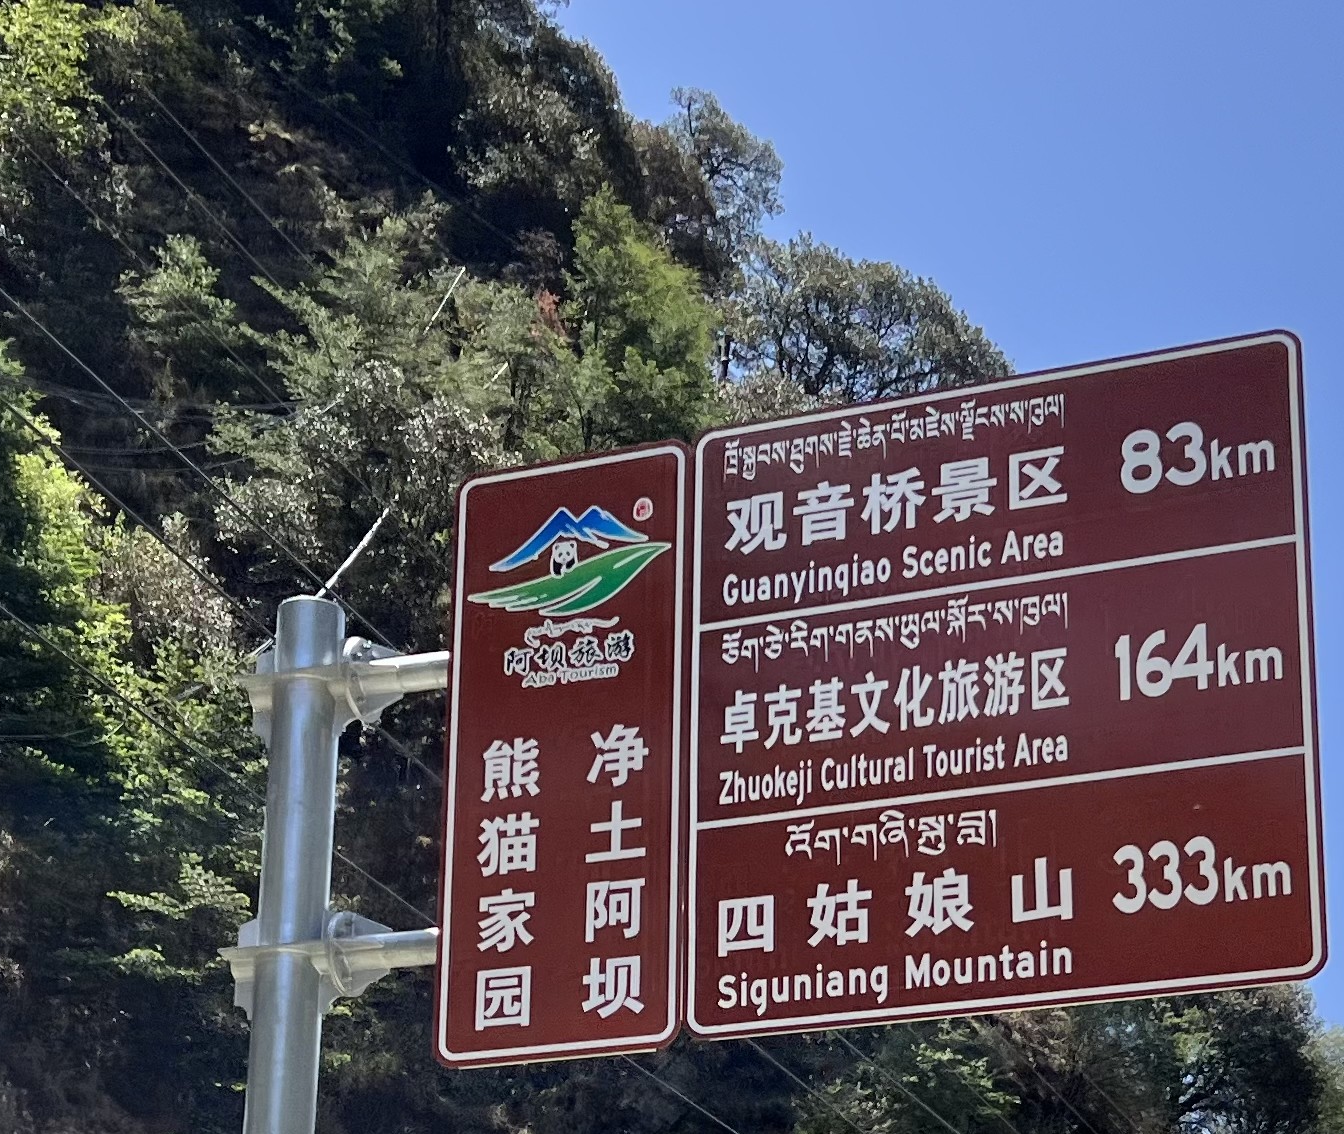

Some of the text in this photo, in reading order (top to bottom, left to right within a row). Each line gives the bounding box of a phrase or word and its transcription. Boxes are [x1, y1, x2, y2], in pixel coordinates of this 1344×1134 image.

[1119, 421, 1276, 494] 83km
[724, 446, 1068, 555] 观音桥景区
[722, 529, 1064, 606] Guanyinqiao Scenic Area
[506, 631, 632, 674] 阿坝旅游
[523, 662, 618, 688] Aba Tourism
[1114, 622, 1283, 701] 164km
[719, 647, 1070, 754] 卓克基文化旅游区
[718, 732, 1069, 805] Zhuokeji Cultural Tourist Area
[474, 736, 541, 1031] 熊猫家园
[581, 723, 650, 1019] 净土阿坝
[717, 856, 1074, 958] 四姑娘山
[1112, 835, 1292, 914] 333km
[717, 939, 1073, 1017] Siguniang Mountain
